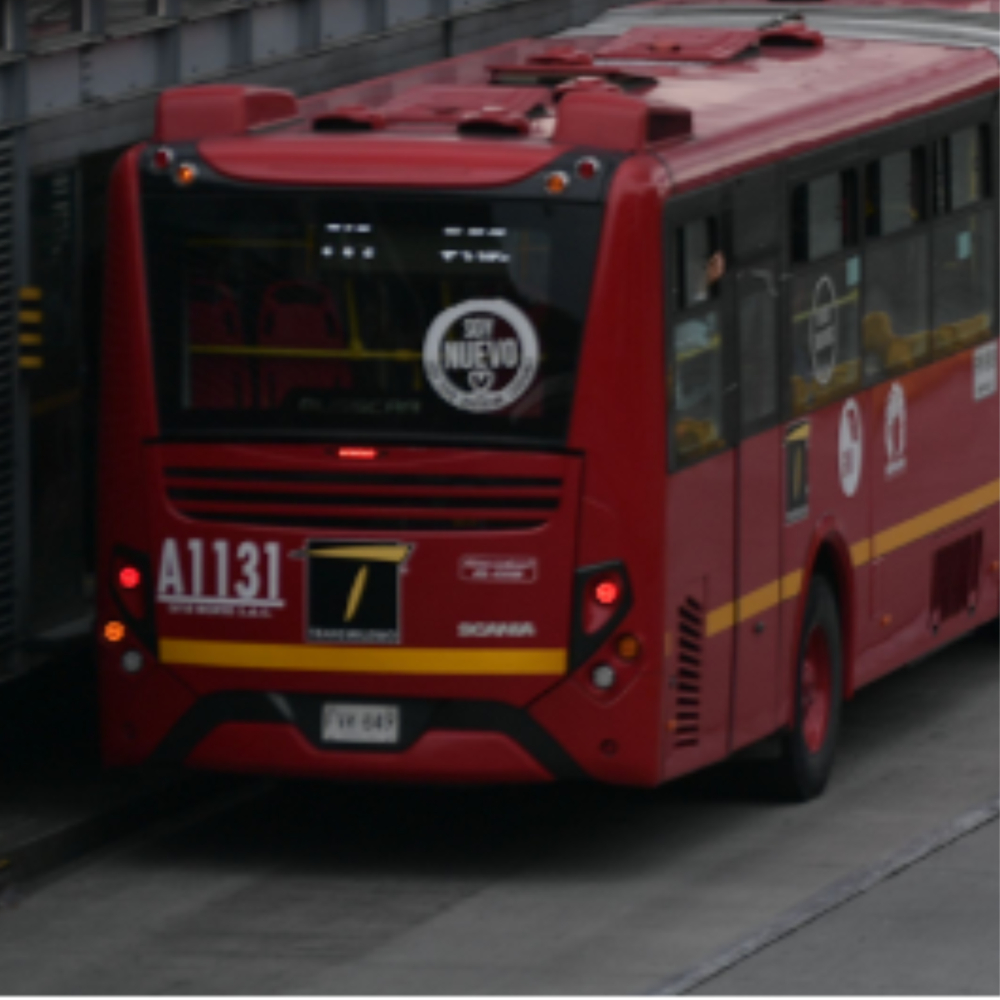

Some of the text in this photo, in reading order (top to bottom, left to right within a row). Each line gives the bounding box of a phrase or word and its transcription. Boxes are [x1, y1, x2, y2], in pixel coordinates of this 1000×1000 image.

[464, 318, 495, 339] SOY
[444, 339, 518, 370] NUEVO
[158, 538, 280, 600] A1131
[457, 621, 536, 638] SCANIA
